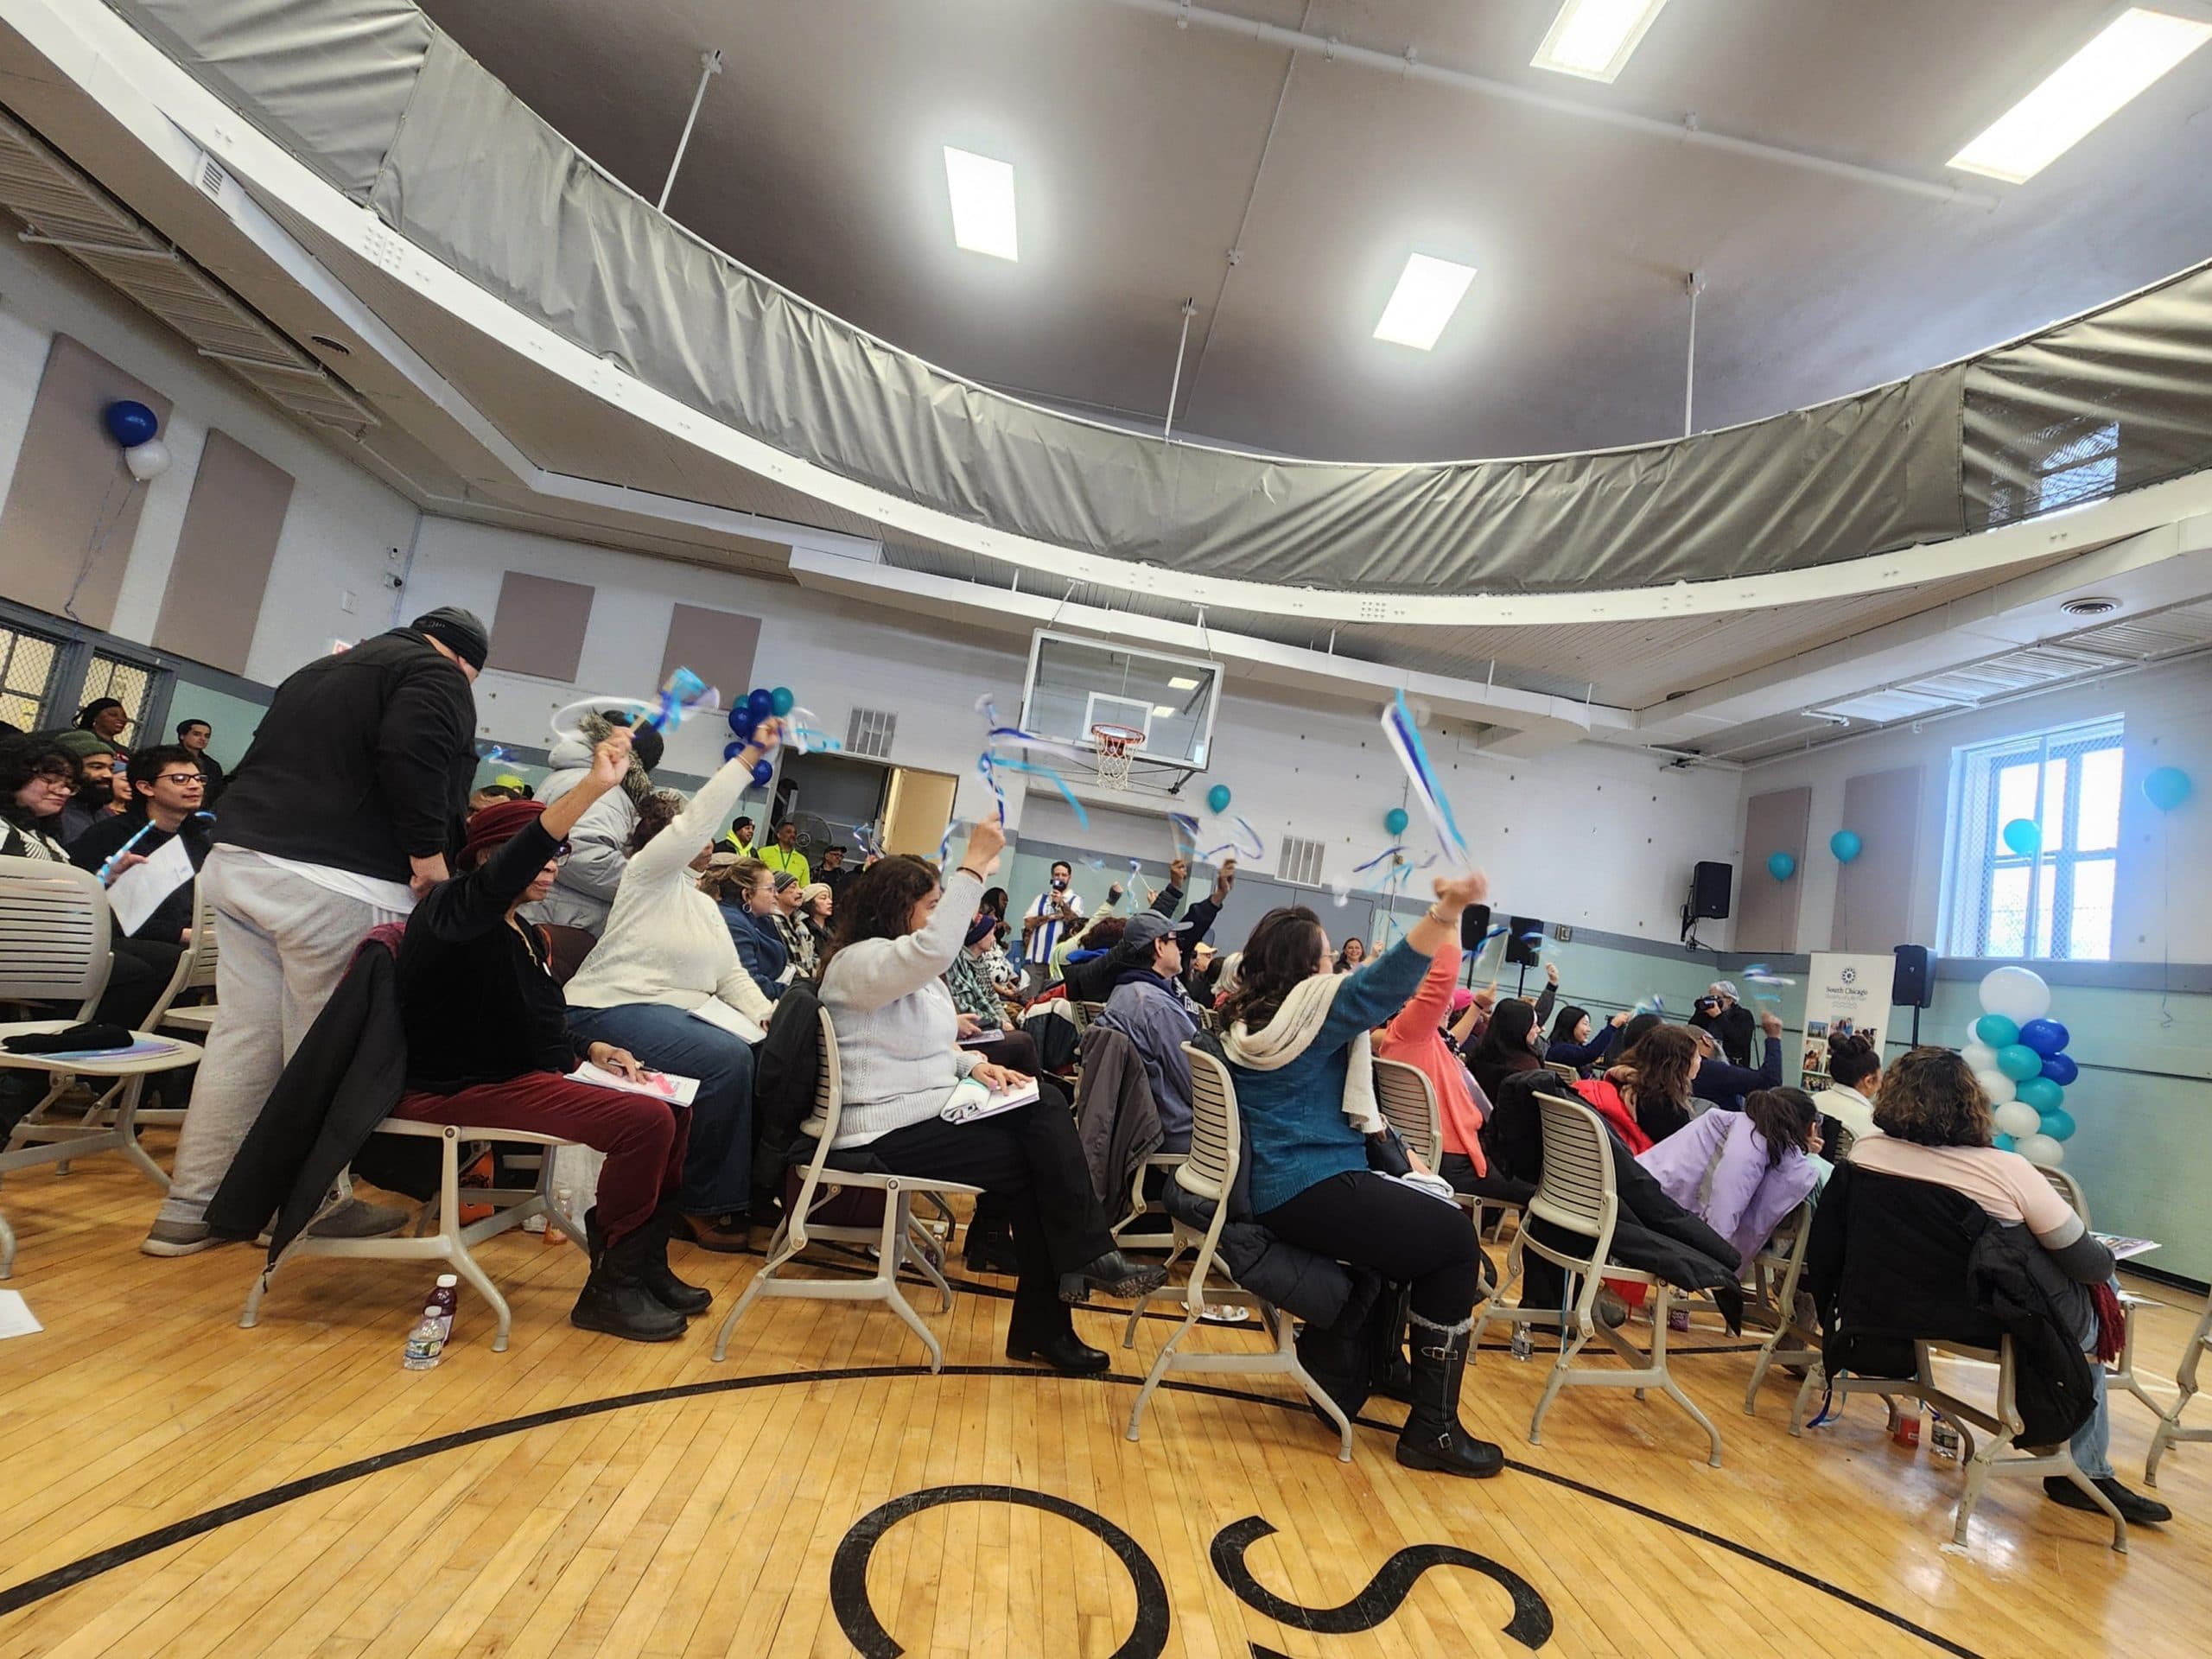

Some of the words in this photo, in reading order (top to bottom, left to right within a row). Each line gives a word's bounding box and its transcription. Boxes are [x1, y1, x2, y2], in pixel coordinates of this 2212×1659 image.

[1825, 986, 1844, 995] South
[1845, 988, 1868, 996] Chicago
[1209, 1515, 1554, 1659] S
